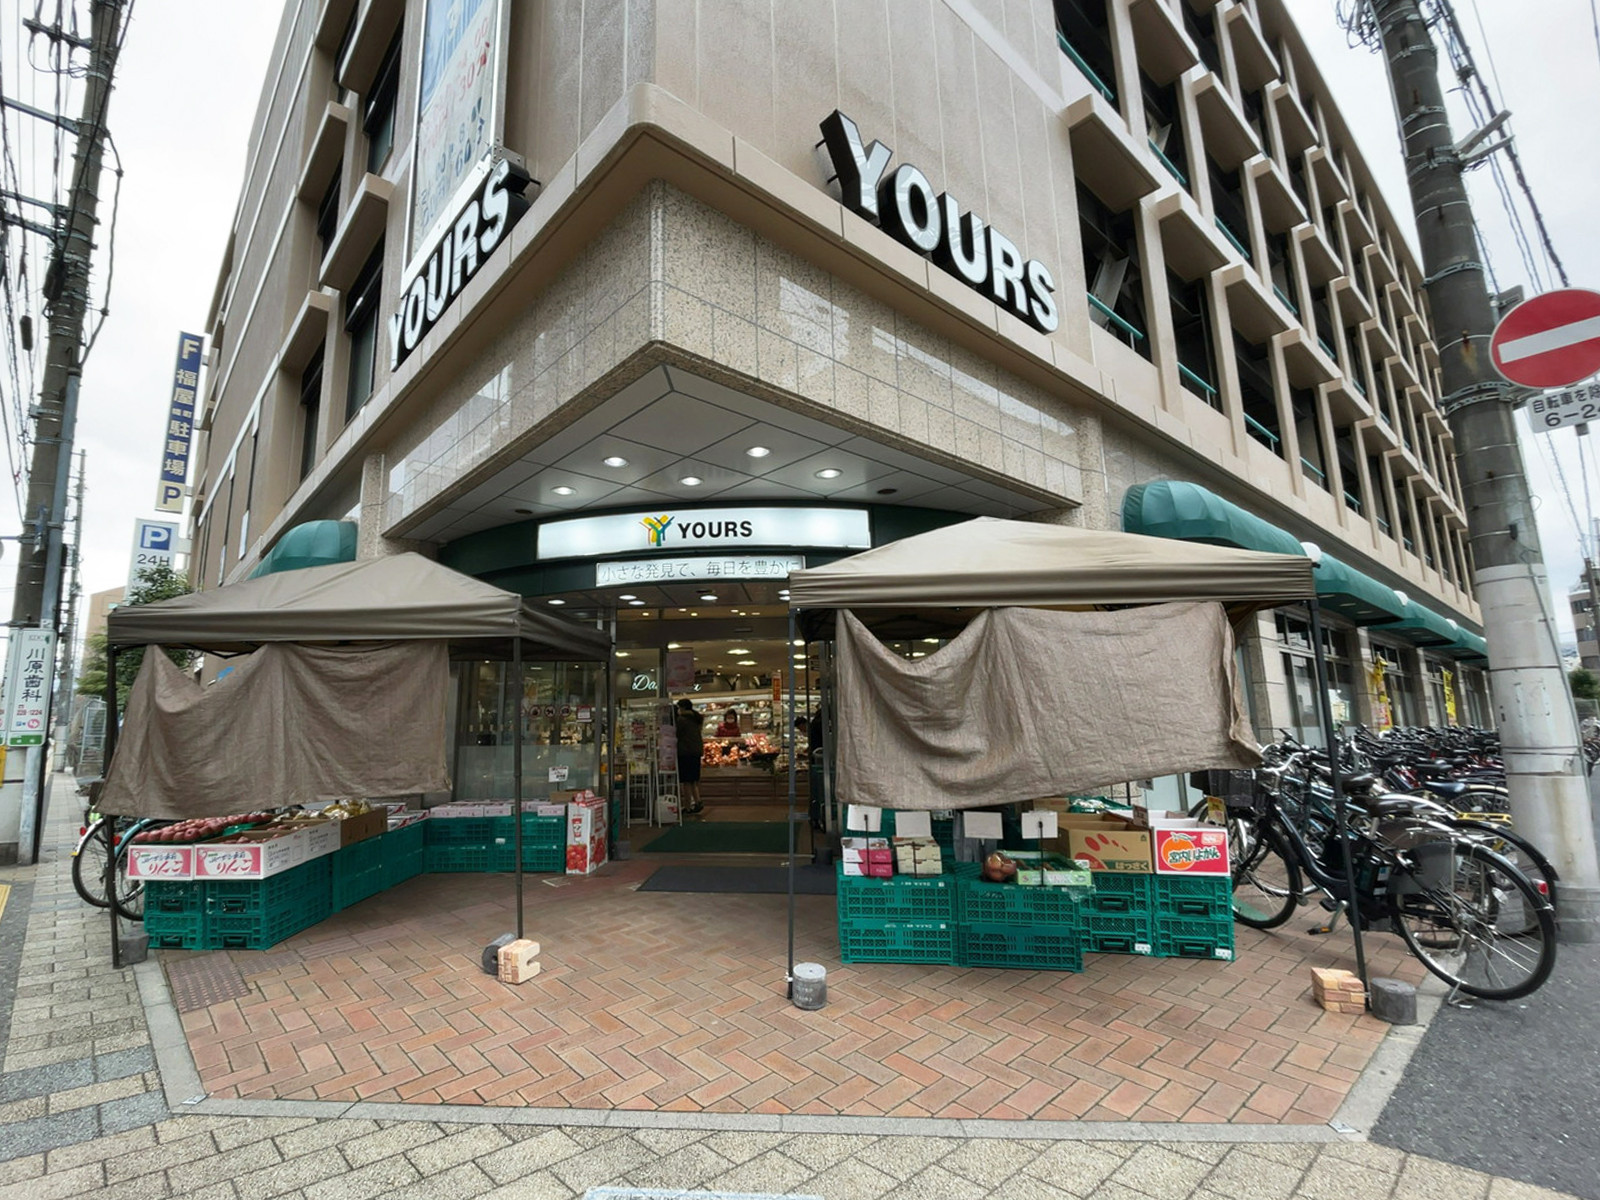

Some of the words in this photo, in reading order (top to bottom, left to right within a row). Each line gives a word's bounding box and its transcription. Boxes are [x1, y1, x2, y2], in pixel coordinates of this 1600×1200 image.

[820, 109, 1060, 334] YOURS
[389, 159, 512, 372] YOURS
[1545, 403, 1600, 427] 6-2
[163, 486, 181, 505] P
[677, 520, 753, 539] YOURS
[137, 553, 170, 566] 24H
[21, 648, 46, 703] 川原歯科
[149, 861, 183, 875] りんご
[217, 859, 252, 875] りんご
[1114, 861, 1149, 871] はっさく
